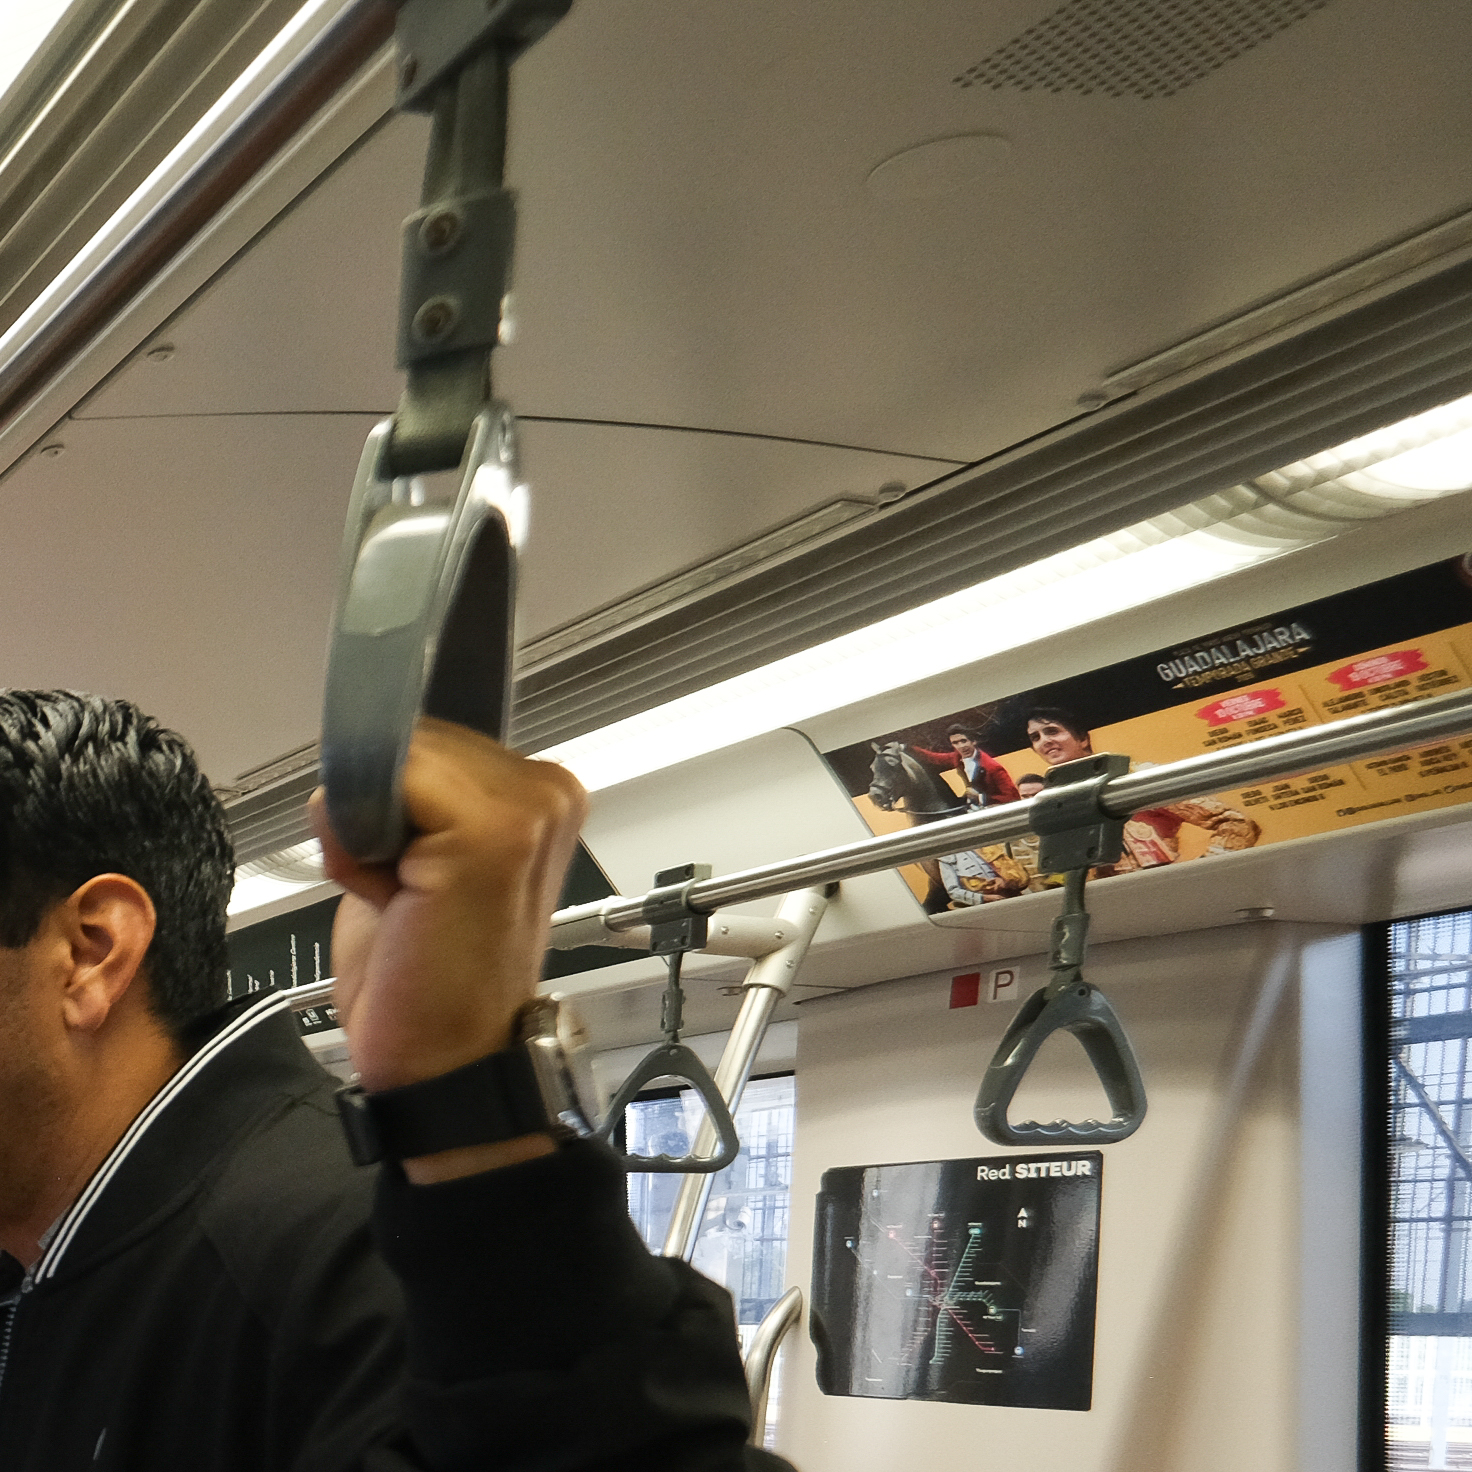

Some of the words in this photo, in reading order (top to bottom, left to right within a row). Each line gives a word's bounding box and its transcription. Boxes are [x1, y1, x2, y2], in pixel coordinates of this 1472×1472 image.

[1157, 622, 1311, 682] GUADALAJARA
[993, 969, 1015, 1000] P
[977, 1163, 1011, 1181] Red
[1014, 1160, 1092, 1179] SITEUR
